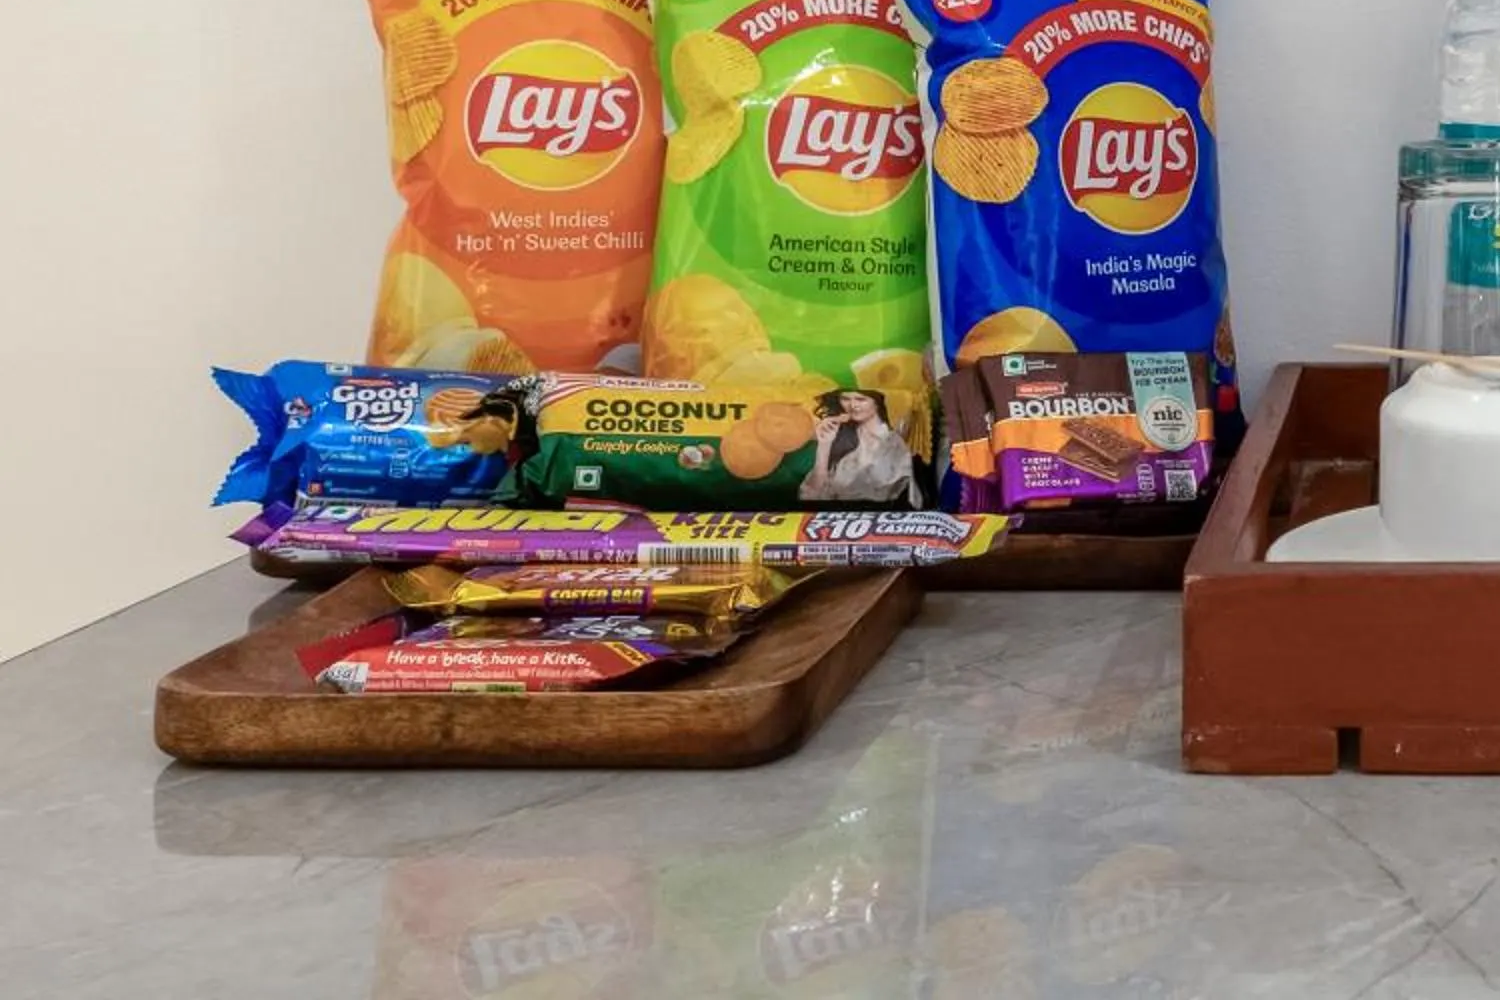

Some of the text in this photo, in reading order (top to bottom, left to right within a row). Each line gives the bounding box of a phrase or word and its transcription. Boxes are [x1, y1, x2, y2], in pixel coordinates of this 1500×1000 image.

[740, 2, 800, 42] 20%
[1024, 20, 1073, 64] 20%
[1069, 9, 1139, 36] MORE
[477, 75, 632, 157] Lay's
[777, 97, 921, 181] Lay's
[1073, 119, 1188, 199] Lay's
[490, 211, 544, 228] West
[456, 233, 495, 252] Hot
[524, 232, 590, 251] Sweet
[594, 231, 644, 250] Chilli
[768, 233, 916, 258] American Style
[768, 256, 916, 276] Cream & Onion
[1086, 251, 1197, 276] India's Magic
[818, 278, 875, 292] Flavour
[1112, 274, 1175, 296] Masala
[1134, 366, 1185, 377] BOURBON
[332, 381, 419, 403] Good
[345, 399, 414, 432] Day
[585, 399, 748, 421] COCONUT
[1008, 397, 1130, 418] BOURBON
[1153, 405, 1183, 421] nic
[585, 418, 685, 434] COOKIES
[583, 437, 633, 455] Crunchy
[670, 511, 786, 527] KING
[690, 525, 750, 538] SIZE
[387, 651, 423, 665] Have
[427, 655, 438, 665] a
[491, 651, 526, 665] have
[529, 655, 539, 665] a
